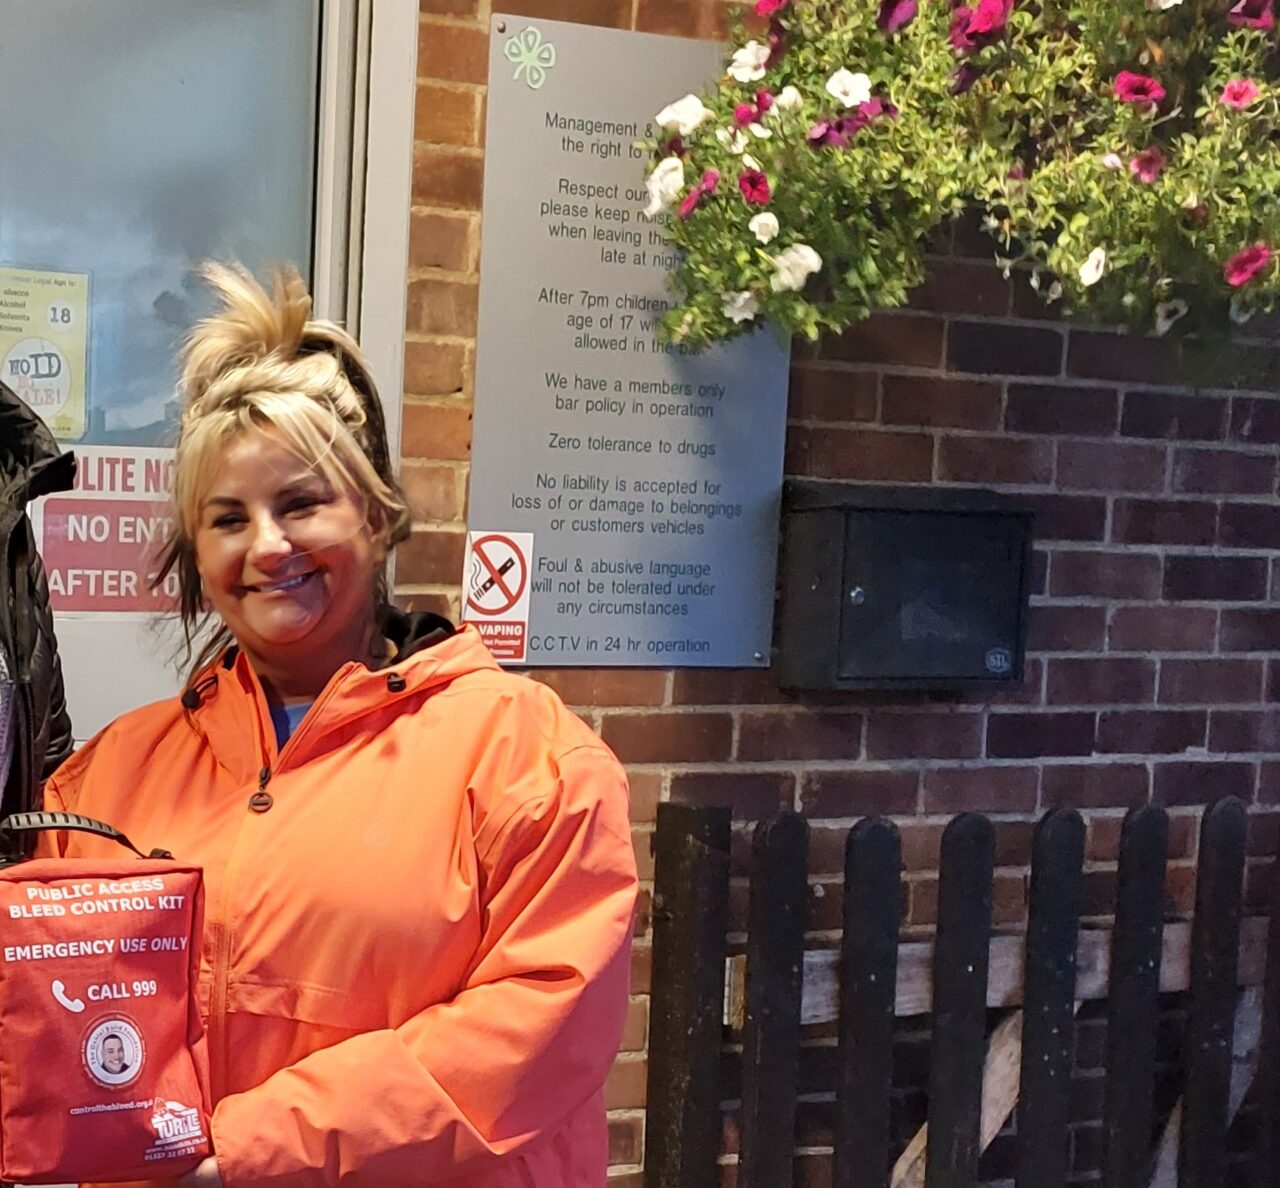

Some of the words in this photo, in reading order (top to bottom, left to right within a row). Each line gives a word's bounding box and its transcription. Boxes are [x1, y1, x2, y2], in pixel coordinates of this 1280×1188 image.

[545, 111, 637, 136] Management
[644, 123, 653, 138] &
[561, 136, 584, 153] the
[590, 138, 621, 159] right
[558, 178, 618, 199] Respect
[540, 200, 588, 218] please
[595, 203, 630, 223] keep
[549, 224, 587, 240] when
[593, 225, 641, 247] leaving
[601, 247, 626, 264] late
[633, 250, 646, 266] at
[538, 287, 574, 305] After
[580, 290, 609, 310] 7pm
[615, 294, 668, 312] children
[50, 306, 71, 324] 18
[567, 315, 593, 331] age
[599, 313, 613, 329] of
[620, 314, 633, 331] 17
[575, 333, 627, 351] allowed
[633, 336, 645, 352] in
[545, 372, 568, 391] We
[574, 373, 607, 392] have
[614, 379, 623, 392] a
[628, 379, 693, 397] members
[698, 383, 726, 401] only
[555, 395, 578, 411] bar
[585, 397, 626, 416] policy
[631, 399, 644, 415] in
[649, 400, 715, 419] operation
[548, 432, 581, 450] Zero
[588, 435, 652, 454] tolerance
[658, 437, 671, 454] to
[677, 439, 716, 458] drugs
[536, 473, 557, 490] No
[562, 474, 609, 495] liability
[615, 476, 626, 492] is
[633, 478, 697, 497] accepted
[704, 479, 722, 496] for
[511, 494, 541, 509] loss
[548, 494, 562, 511] of
[568, 497, 582, 511] or
[589, 497, 644, 517] damage
[651, 499, 664, 514] to
[670, 500, 742, 519] belongings
[67, 514, 110, 543] NO
[550, 517, 565, 531] or
[572, 517, 644, 534] customers
[651, 518, 704, 535] vehicles
[538, 556, 568, 573] Foul
[573, 558, 584, 574] &
[591, 559, 643, 575] abusive
[649, 560, 711, 581] language
[48, 568, 138, 597] AFTER
[531, 577, 552, 593] will
[558, 578, 580, 594] not
[587, 578, 604, 594] be
[612, 579, 671, 597] tolerated
[677, 580, 716, 597] under
[557, 601, 582, 618] any
[589, 598, 688, 616] circumstances
[478, 624, 523, 636] VAPING
[586, 636, 598, 651] in
[604, 637, 621, 651] 24
[627, 637, 641, 652] hr
[647, 638, 710, 655] operation
[26, 883, 94, 901] PUBLIC
[98, 878, 165, 896] ACCESS
[8, 903, 66, 920] BLEED
[70, 897, 155, 916] CONTROL
[159, 895, 185, 911] KIT
[4, 939, 115, 962] EMERGENCY
[120, 936, 147, 953] USE
[151, 935, 188, 952] ONLY
[87, 983, 131, 1001] CALL
[132, 980, 157, 997] 999
